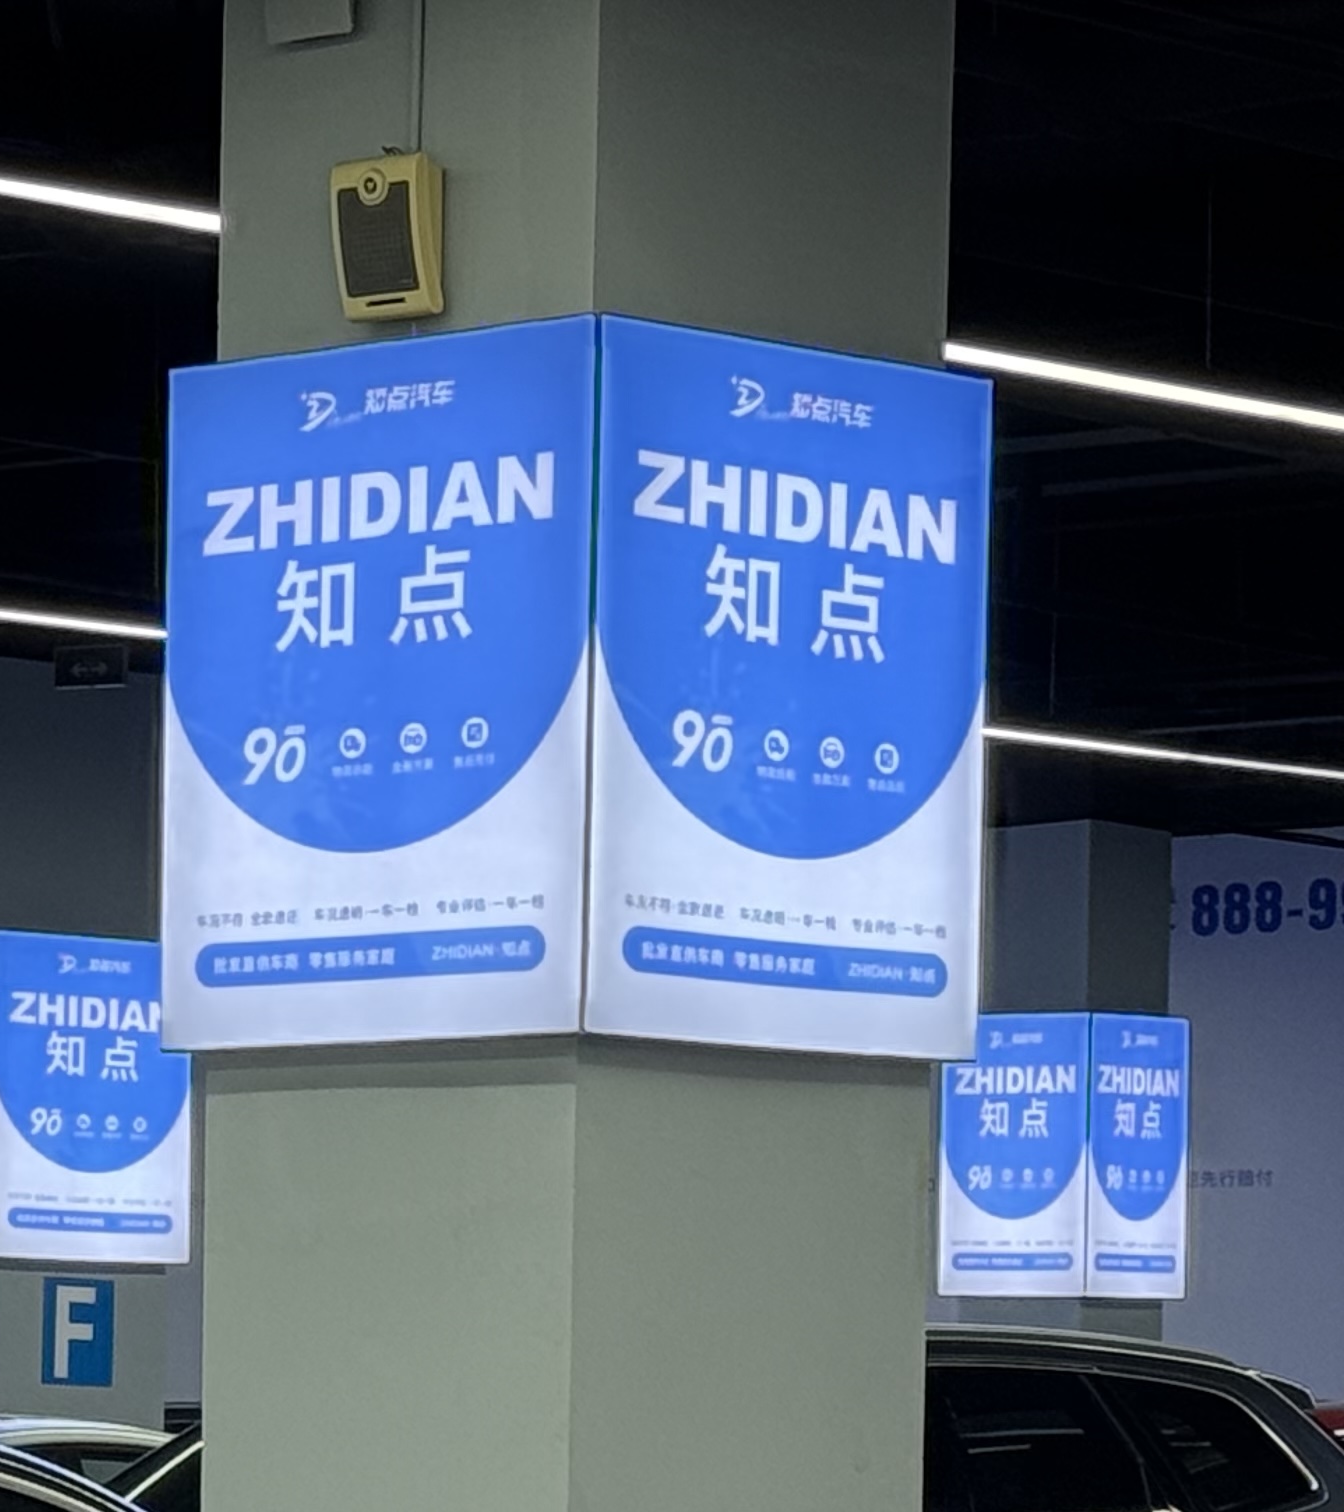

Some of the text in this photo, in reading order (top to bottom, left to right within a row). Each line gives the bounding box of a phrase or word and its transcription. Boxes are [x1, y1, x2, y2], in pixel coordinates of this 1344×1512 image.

[202, 451, 556, 556] ZHIDIAN
[634, 449, 958, 565] ZHIDIAN
[275, 545, 474, 653] 知点
[704, 544, 886, 663] 知点
[1192, 877, 1344, 936] 888-9
[46, 1030, 139, 1082] 知点
[954, 1065, 1076, 1095] ZHIDIAN
[1097, 1065, 1179, 1098] ZHIDIAN
[979, 1098, 1048, 1138] 知点
[1114, 1099, 1161, 1139] 知点
[54, 1285, 96, 1378] F
